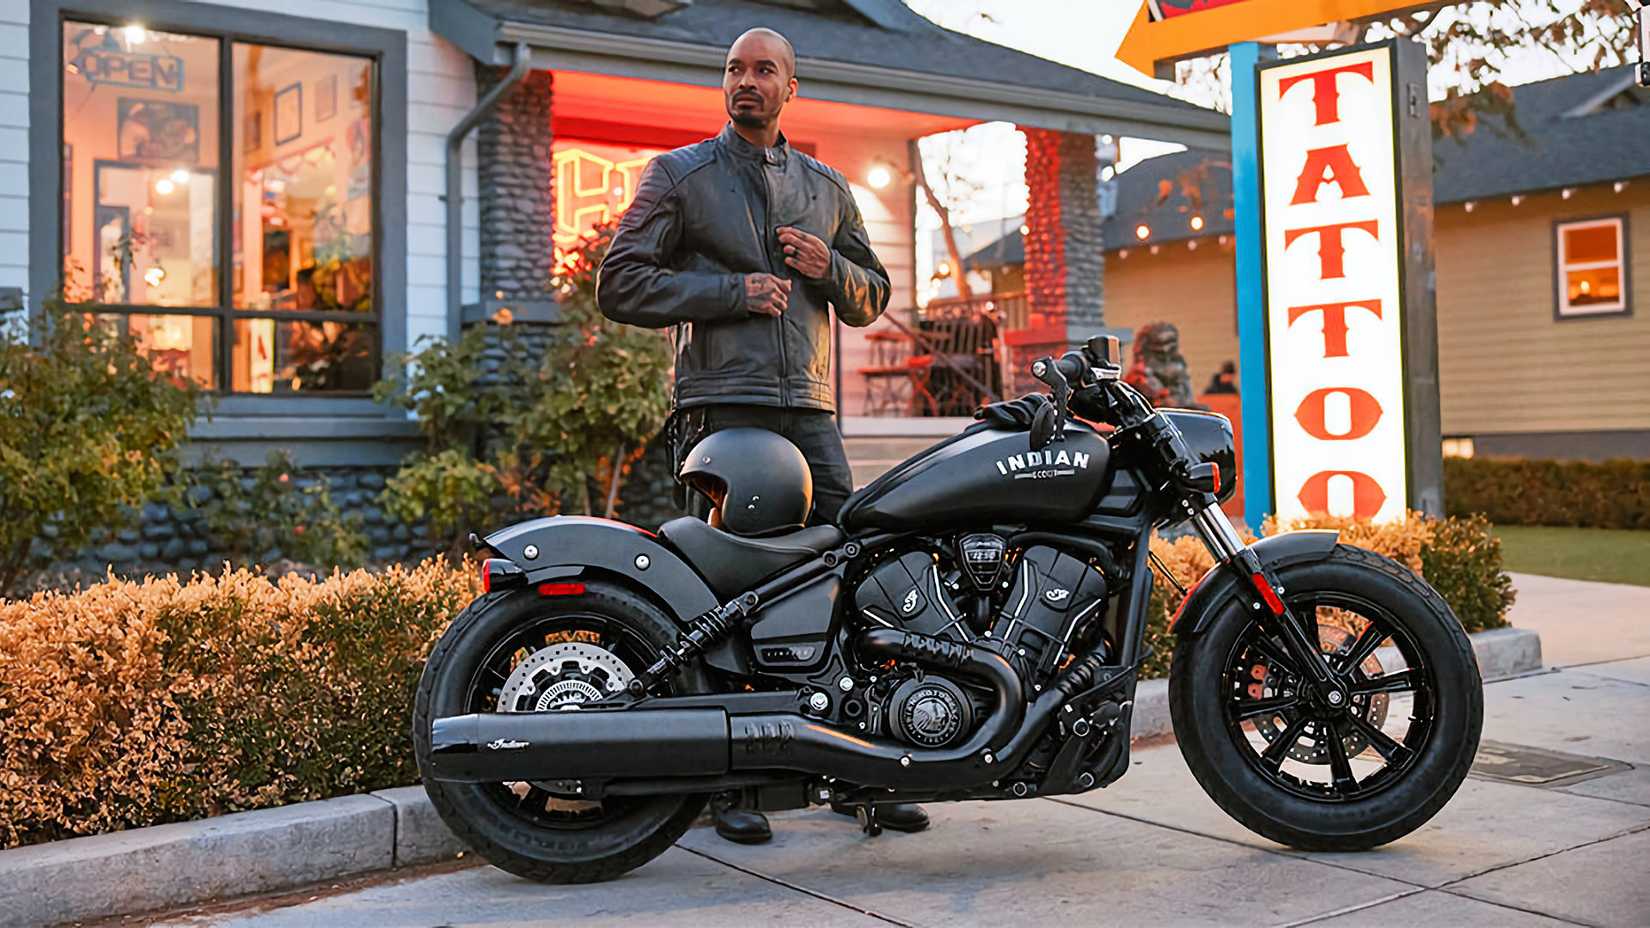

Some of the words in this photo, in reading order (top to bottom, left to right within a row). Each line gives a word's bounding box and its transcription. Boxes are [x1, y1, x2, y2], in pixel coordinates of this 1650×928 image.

[82, 54, 177, 86] OPEN
[1278, 60, 1387, 521] TATTOO
[996, 450, 1090, 475] INDIAN
